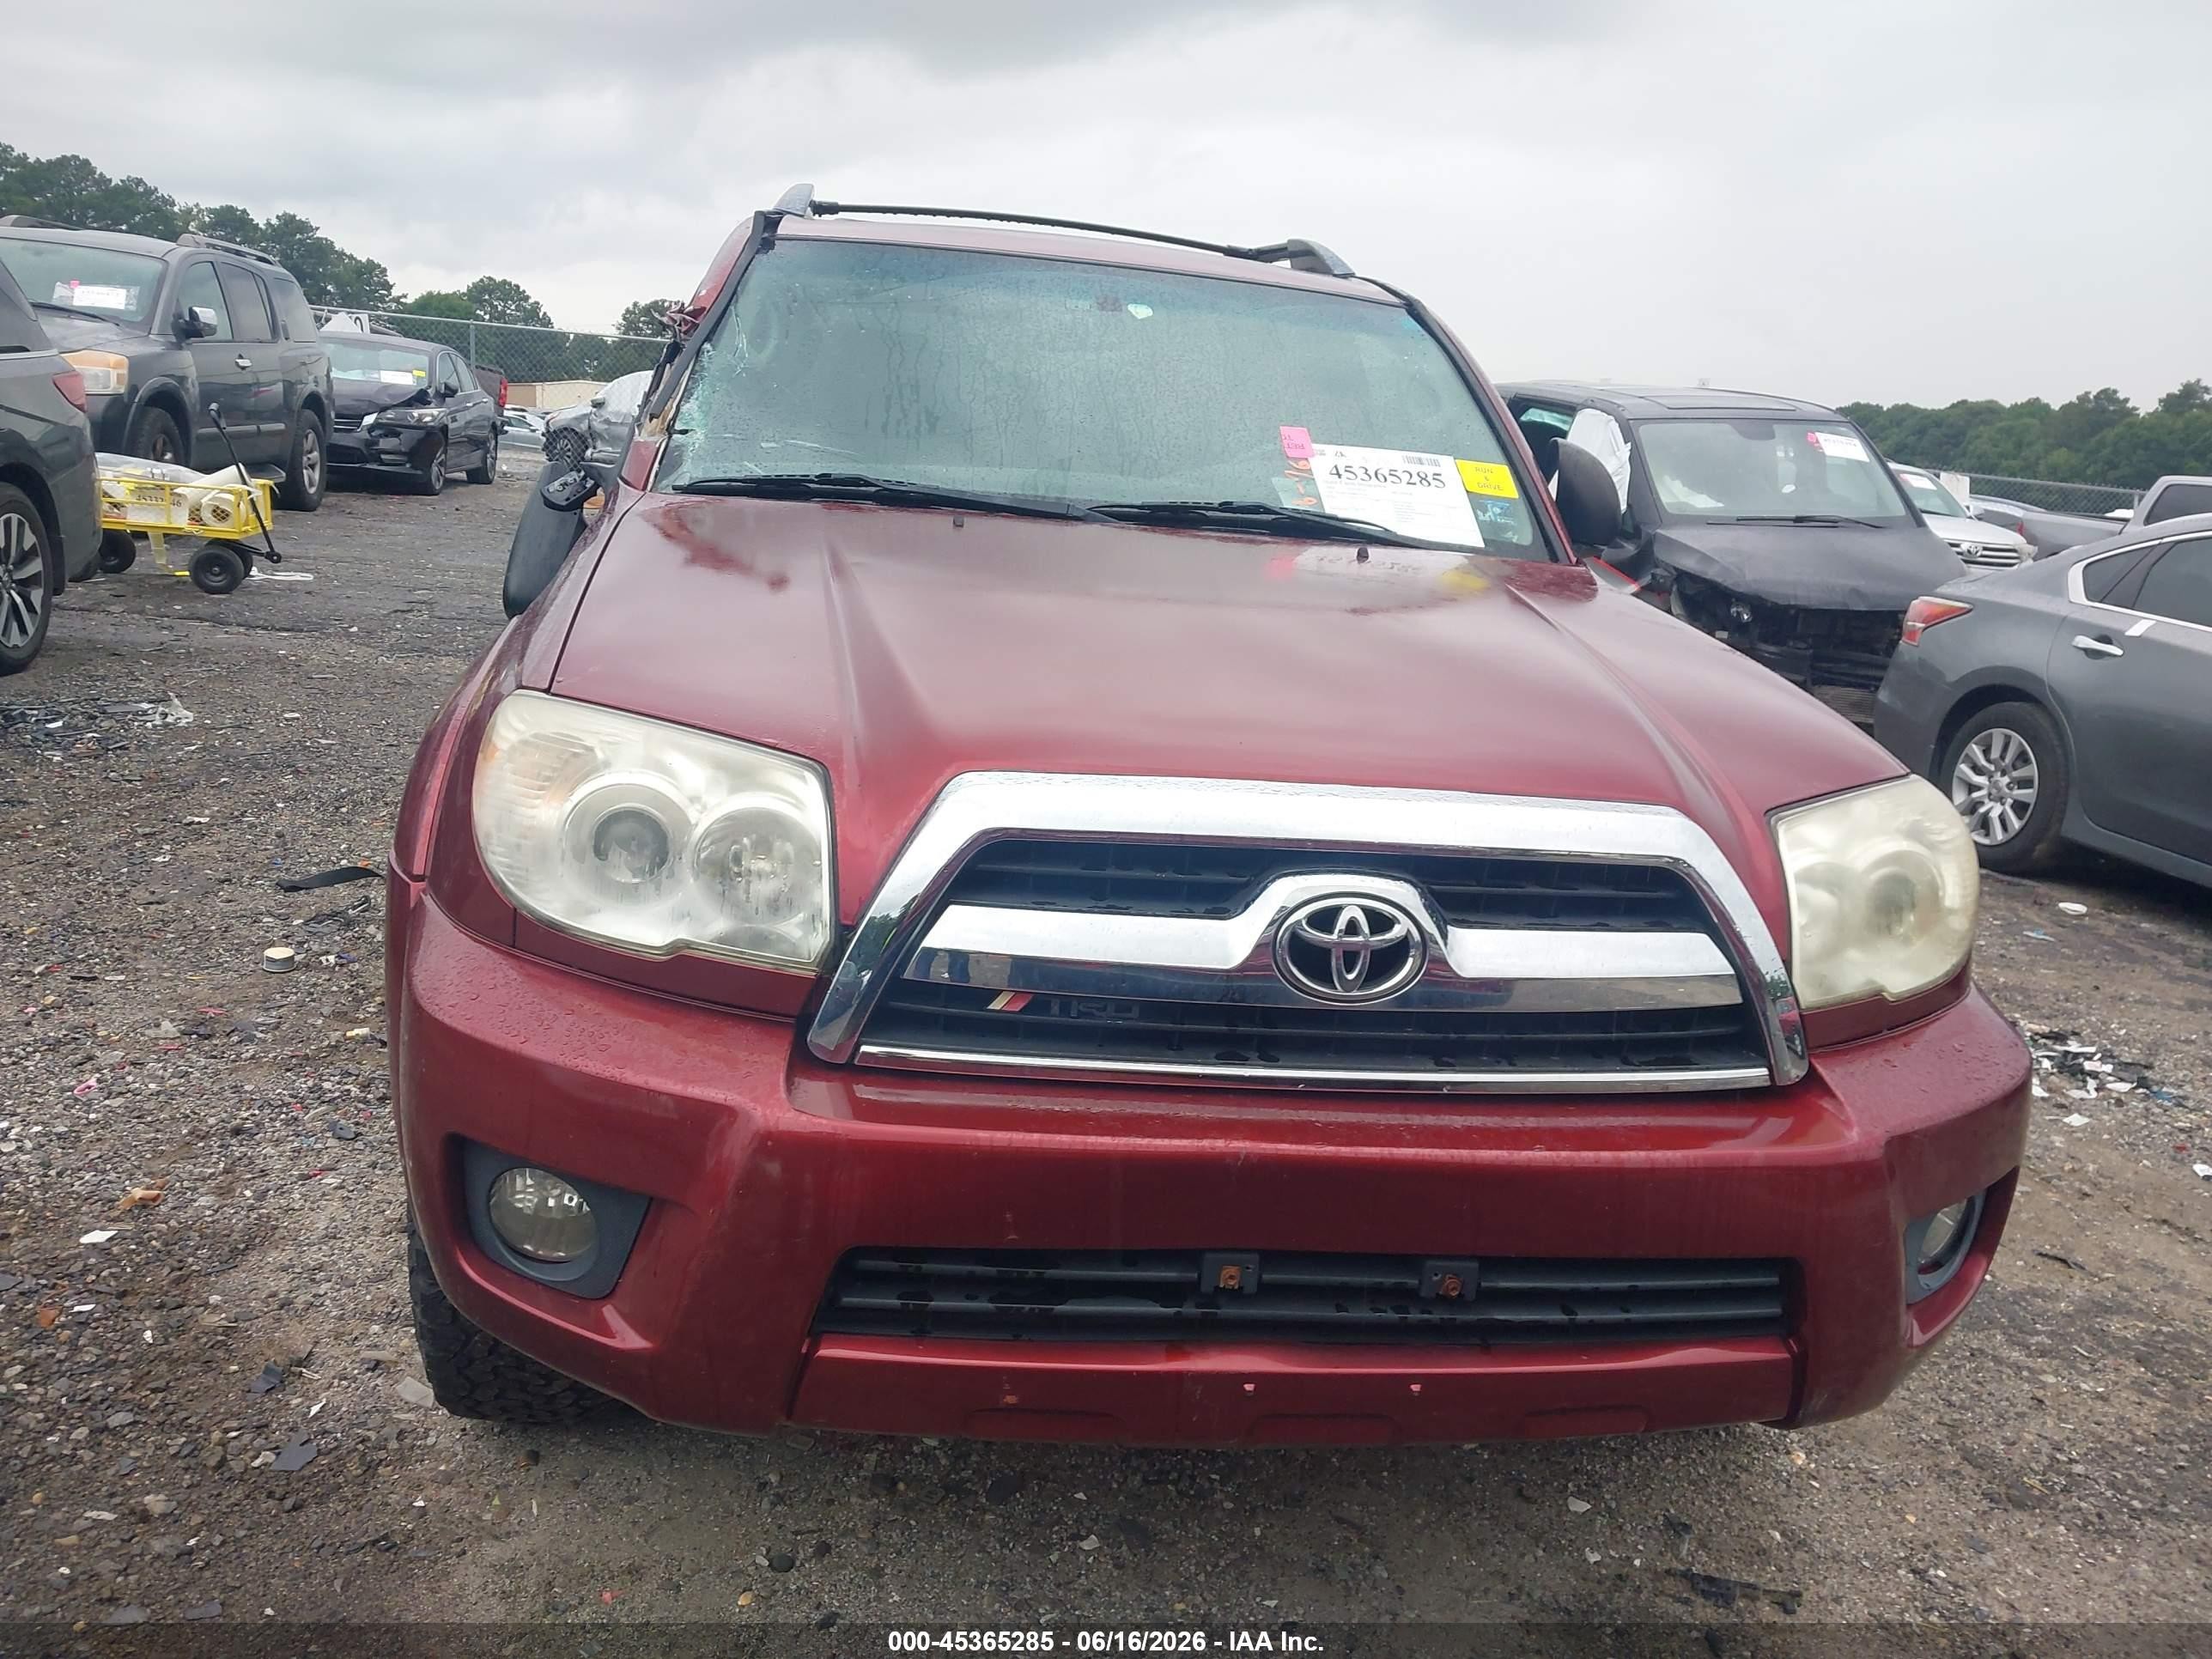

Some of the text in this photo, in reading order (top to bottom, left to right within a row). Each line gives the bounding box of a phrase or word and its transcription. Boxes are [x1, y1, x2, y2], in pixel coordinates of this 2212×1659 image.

[1474, 466, 1494, 475] RUN
[1328, 464, 1447, 489] 45365285
[1476, 482, 1504, 491] DRIVE
